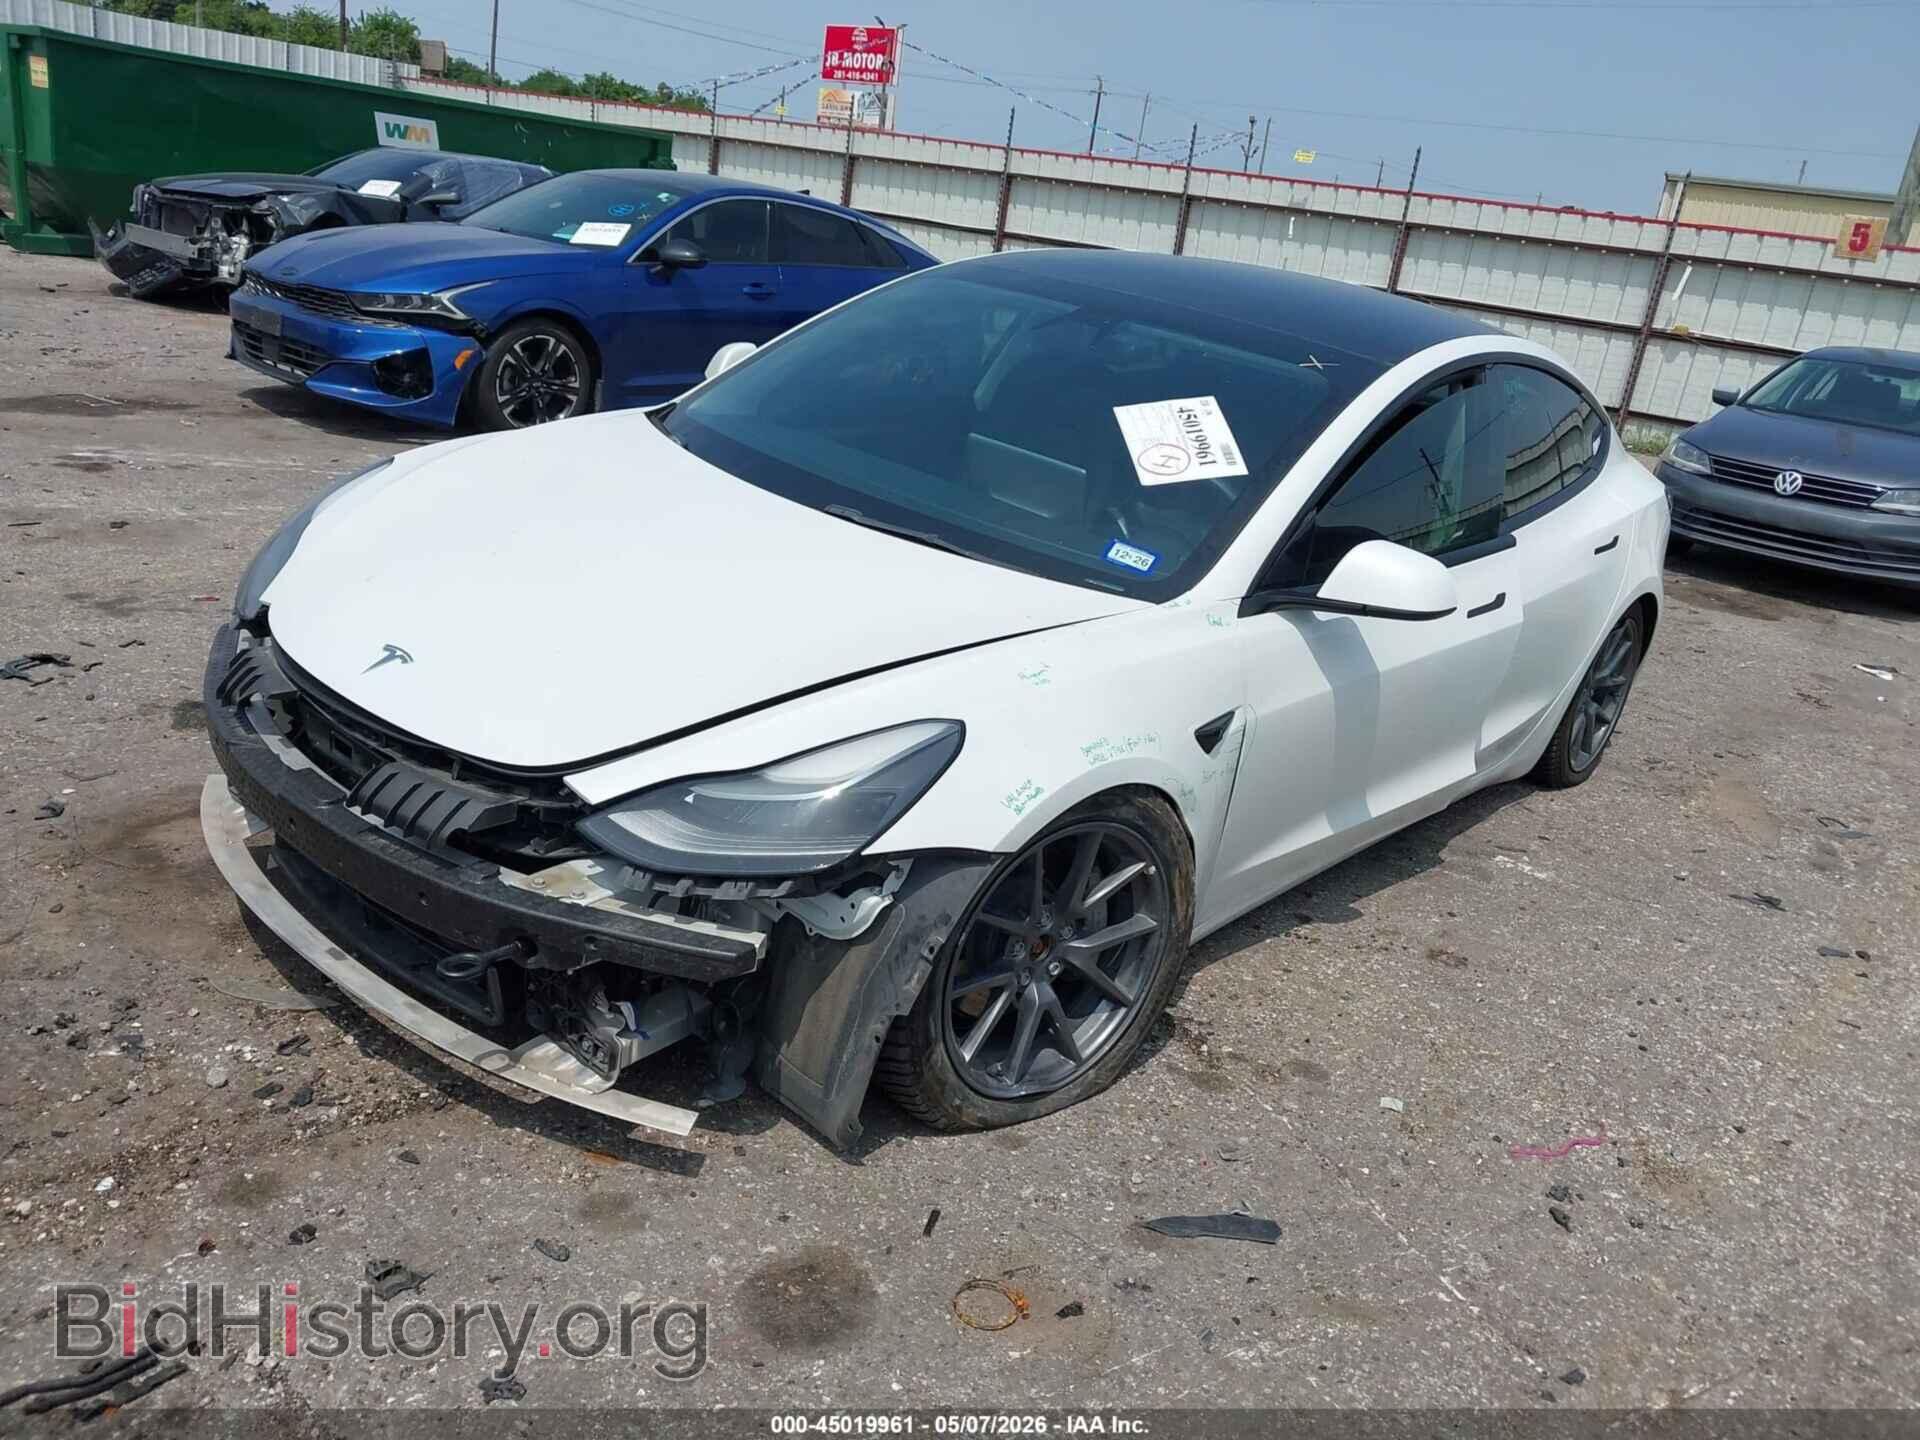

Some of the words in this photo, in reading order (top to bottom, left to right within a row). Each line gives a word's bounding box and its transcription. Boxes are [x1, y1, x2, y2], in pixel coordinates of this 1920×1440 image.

[384, 122, 430, 143] WM
[1848, 223, 1872, 252] 5
[1177, 407, 1217, 467] 45019961
